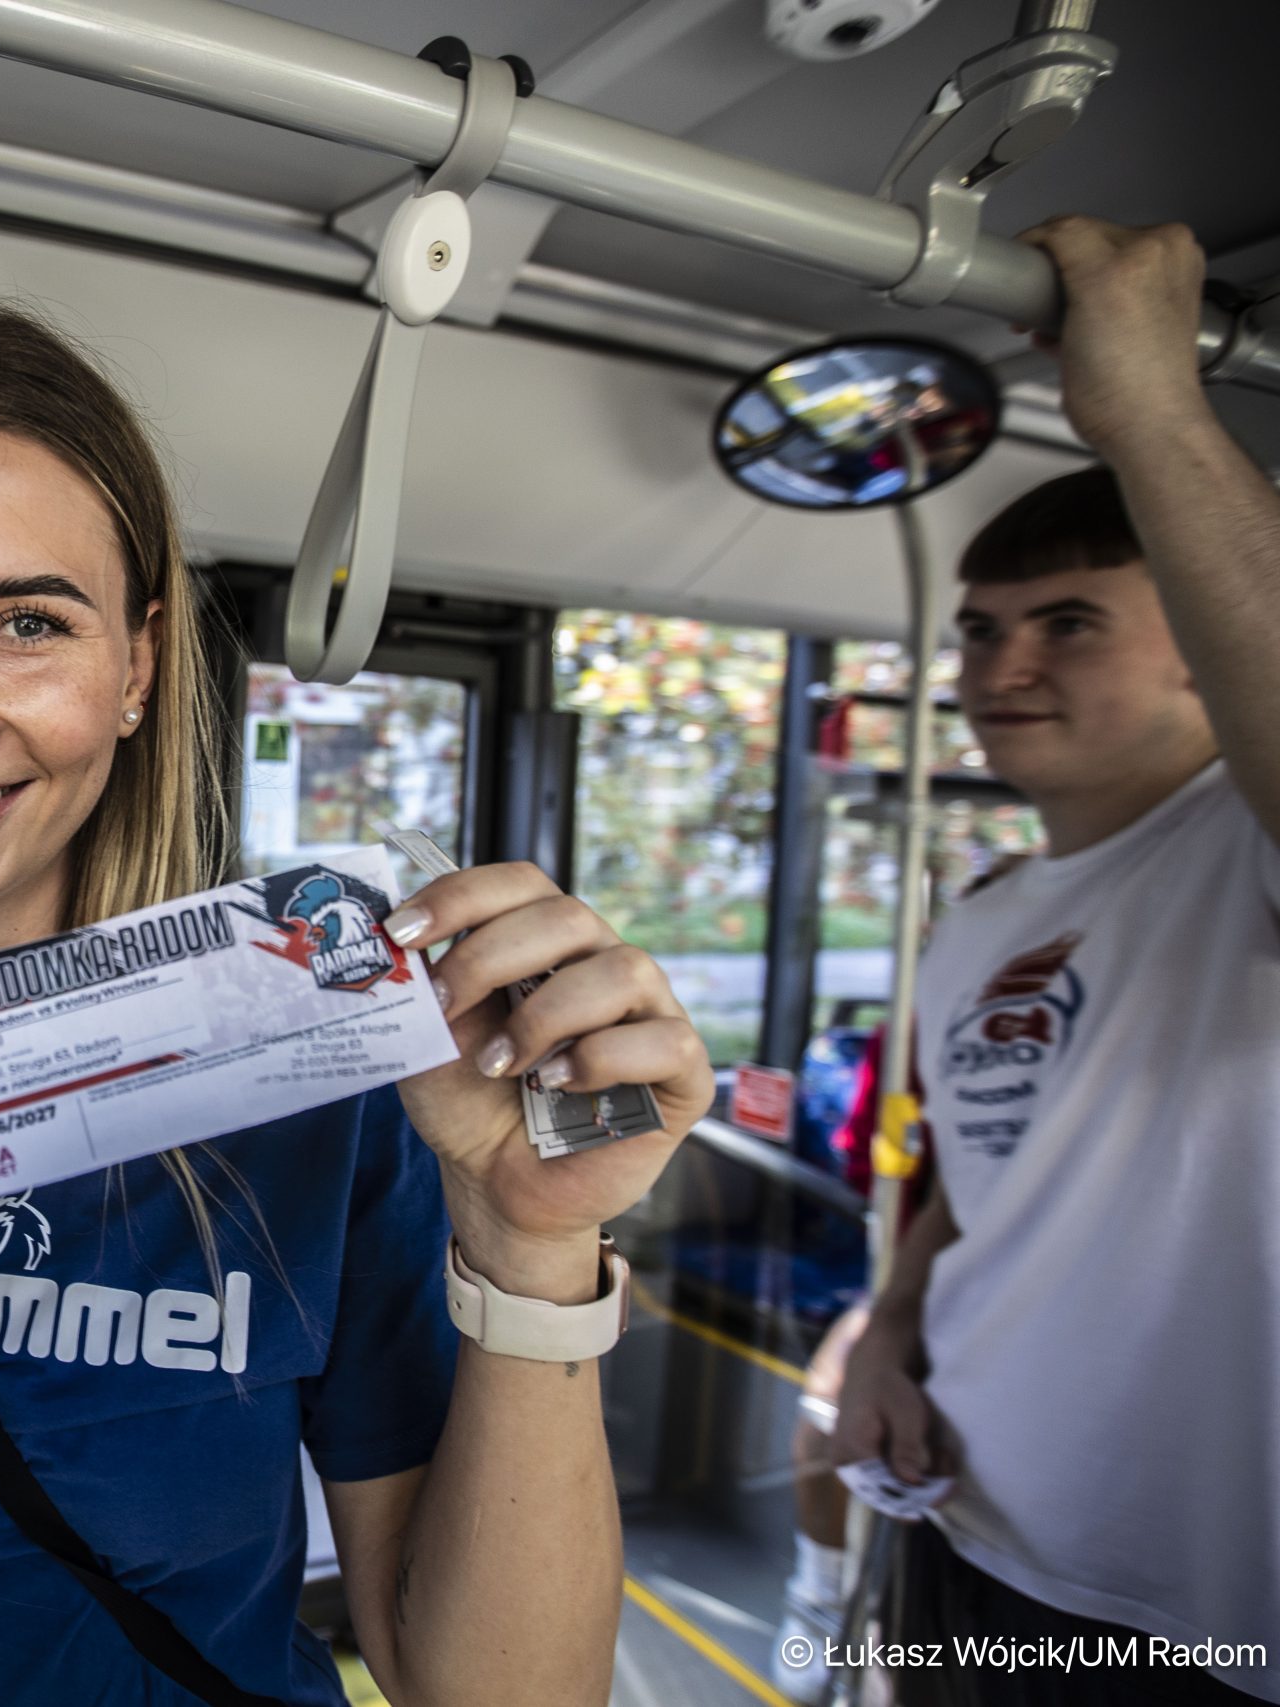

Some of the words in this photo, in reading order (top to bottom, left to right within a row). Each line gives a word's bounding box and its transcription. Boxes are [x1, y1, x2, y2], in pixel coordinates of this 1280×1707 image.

[118, 901, 235, 972] RADOM
[311, 936, 393, 985] RADOMKA
[74, 1036, 119, 1054] Radom
